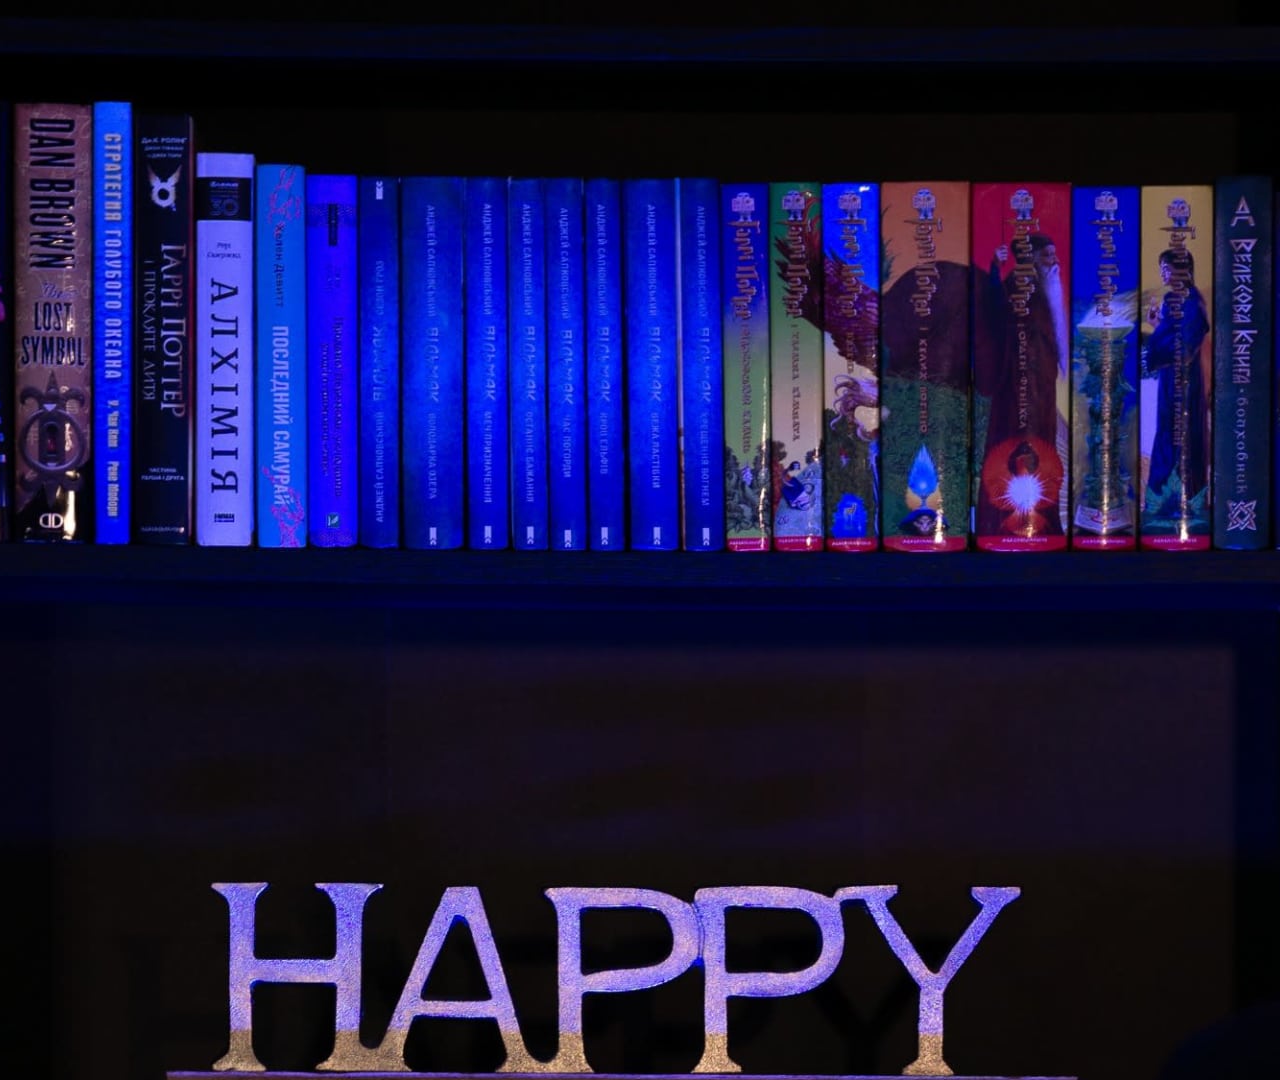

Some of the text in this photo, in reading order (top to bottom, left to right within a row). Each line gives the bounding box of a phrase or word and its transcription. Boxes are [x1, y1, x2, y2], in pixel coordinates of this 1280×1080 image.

[30, 118, 75, 269] DAN BROWN
[103, 132, 122, 379] СТРАТЕГИЯ ГОЛУБОГО ОКЕАНА
[728, 220, 761, 320] Гаррі Поттер
[774, 219, 811, 259] Гаррі
[827, 219, 868, 318] Гаррі Поттер
[904, 218, 943, 259] Гаррі
[1006, 218, 1041, 259] Гаррі
[1092, 219, 1124, 258] Гаррі
[784, 263, 811, 318] Поттер
[909, 264, 941, 318] Поттер
[1008, 264, 1039, 317] Поттер
[1094, 264, 1120, 316] Поттер
[1160, 226, 1196, 320] Гаррі Поттер
[35, 302, 72, 331] LOST
[141, 271, 156, 352] ПРОКЛЯТЕ
[21, 336, 85, 366] SYMBOL
[160, 317, 187, 418] ПОТТЕР
[211, 278, 238, 493] АЛХІМІЯ
[270, 326, 294, 505] ПОСЛЕДНИЙ САМУРАЙ
[210, 882, 1021, 1077] HAPPY
